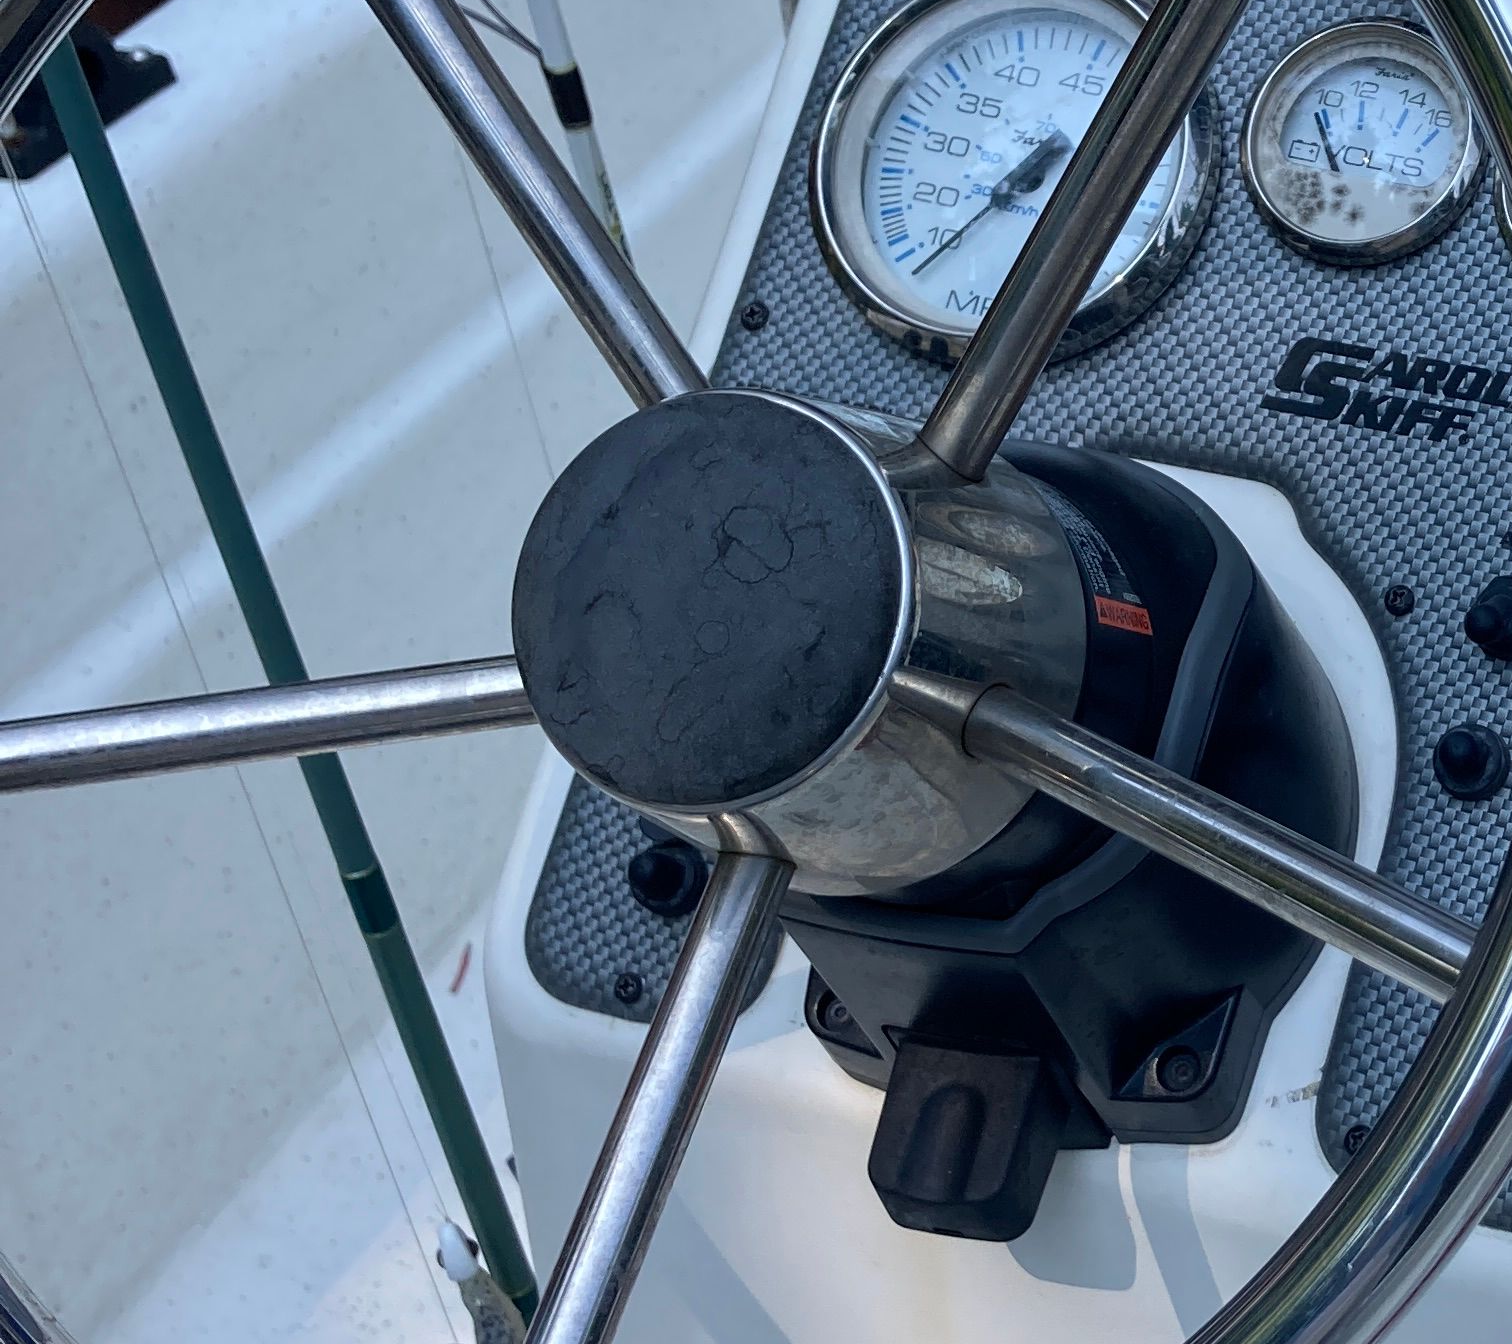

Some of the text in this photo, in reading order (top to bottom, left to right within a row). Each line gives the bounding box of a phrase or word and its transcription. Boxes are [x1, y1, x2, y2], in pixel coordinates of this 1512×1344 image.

[994, 64, 1040, 87] 40
[1058, 72, 1107, 96] 45
[956, 92, 1003, 118] 35
[1316, 80, 1453, 128] 10 12 14 16
[924, 131, 970, 157] 30
[1325, 145, 1424, 177] VOLTS
[913, 181, 960, 208] 20
[928, 226, 963, 250] 10
[1259, 361, 1478, 443] SKIFF
[1107, 605, 1149, 630] WARNING
